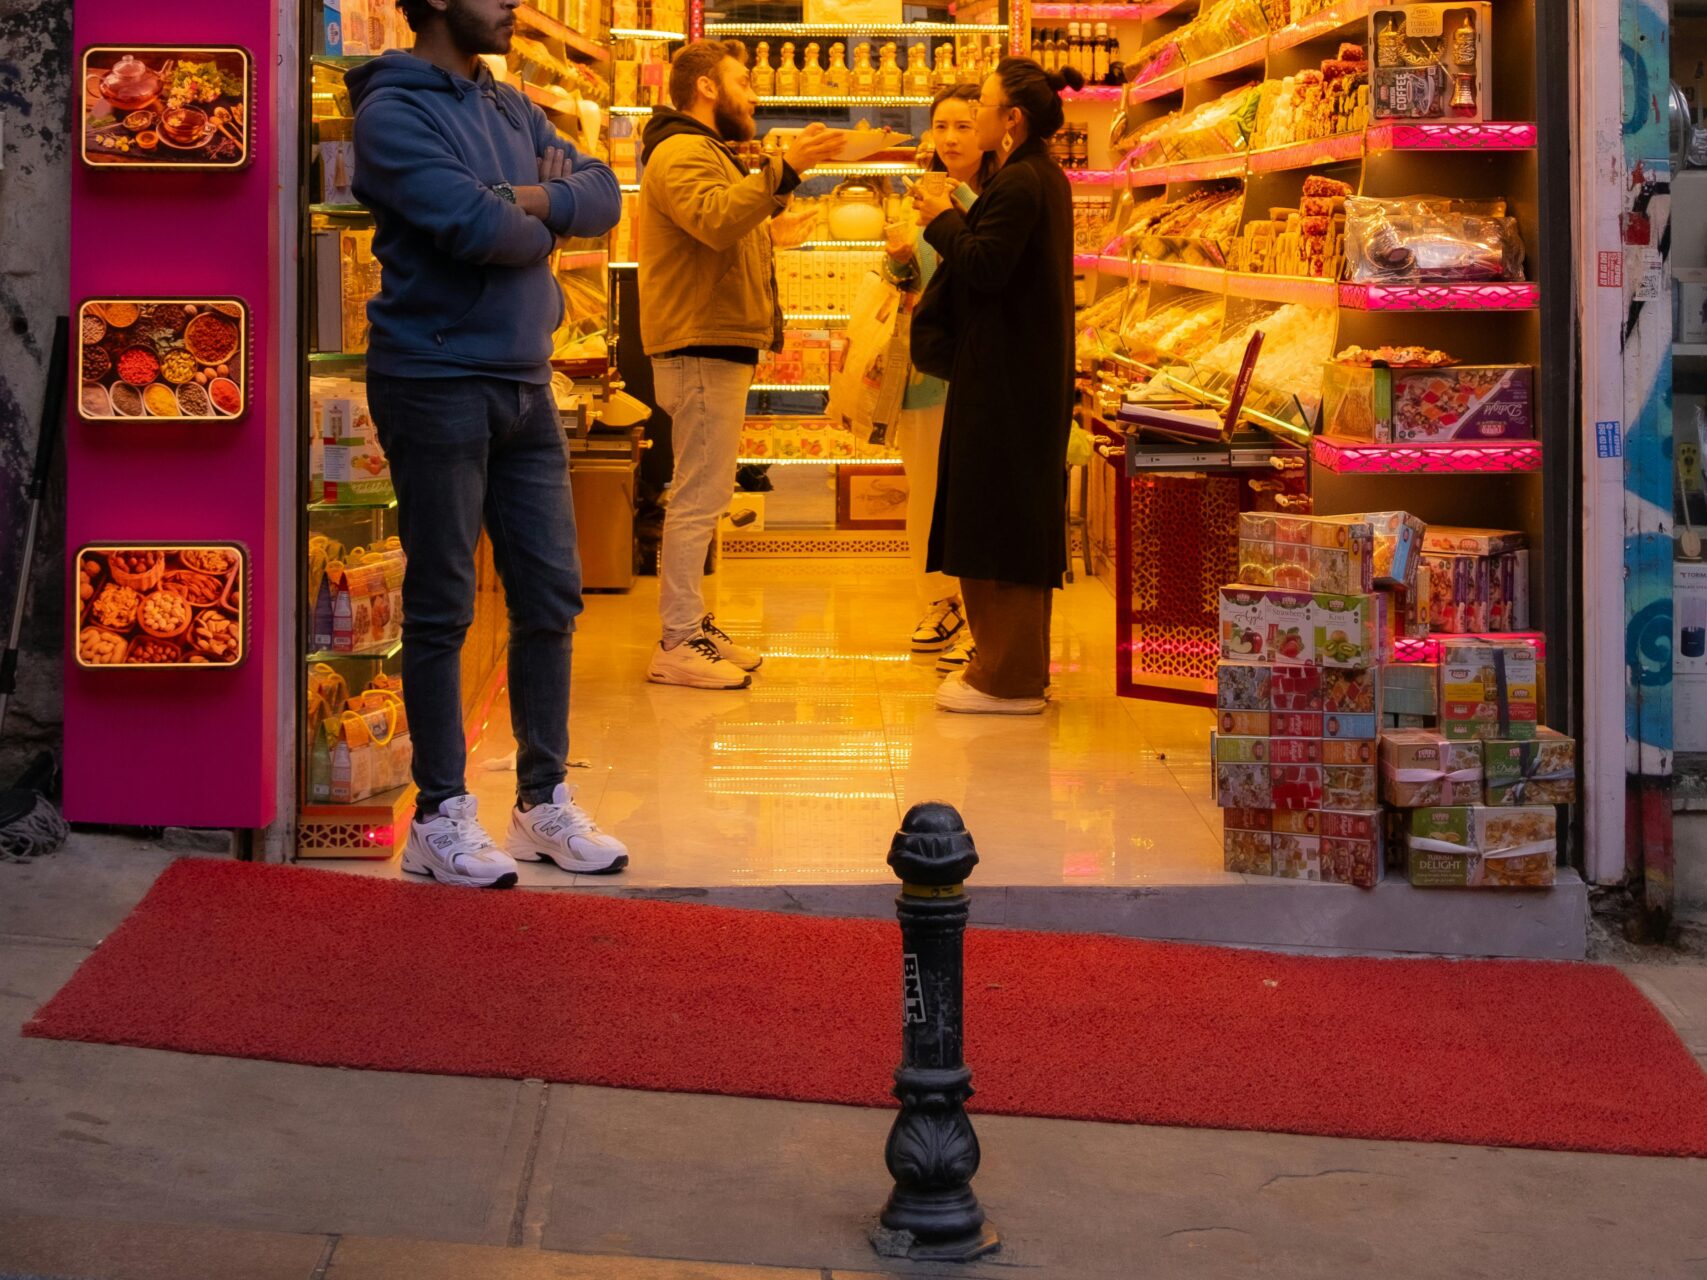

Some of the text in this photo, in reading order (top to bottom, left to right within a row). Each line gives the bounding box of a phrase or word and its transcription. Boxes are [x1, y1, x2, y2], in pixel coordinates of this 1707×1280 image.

[1396, 73, 1407, 111] COFFEE
[1420, 860, 1462, 870] DELIGHT
[904, 956, 923, 1020] BNT
